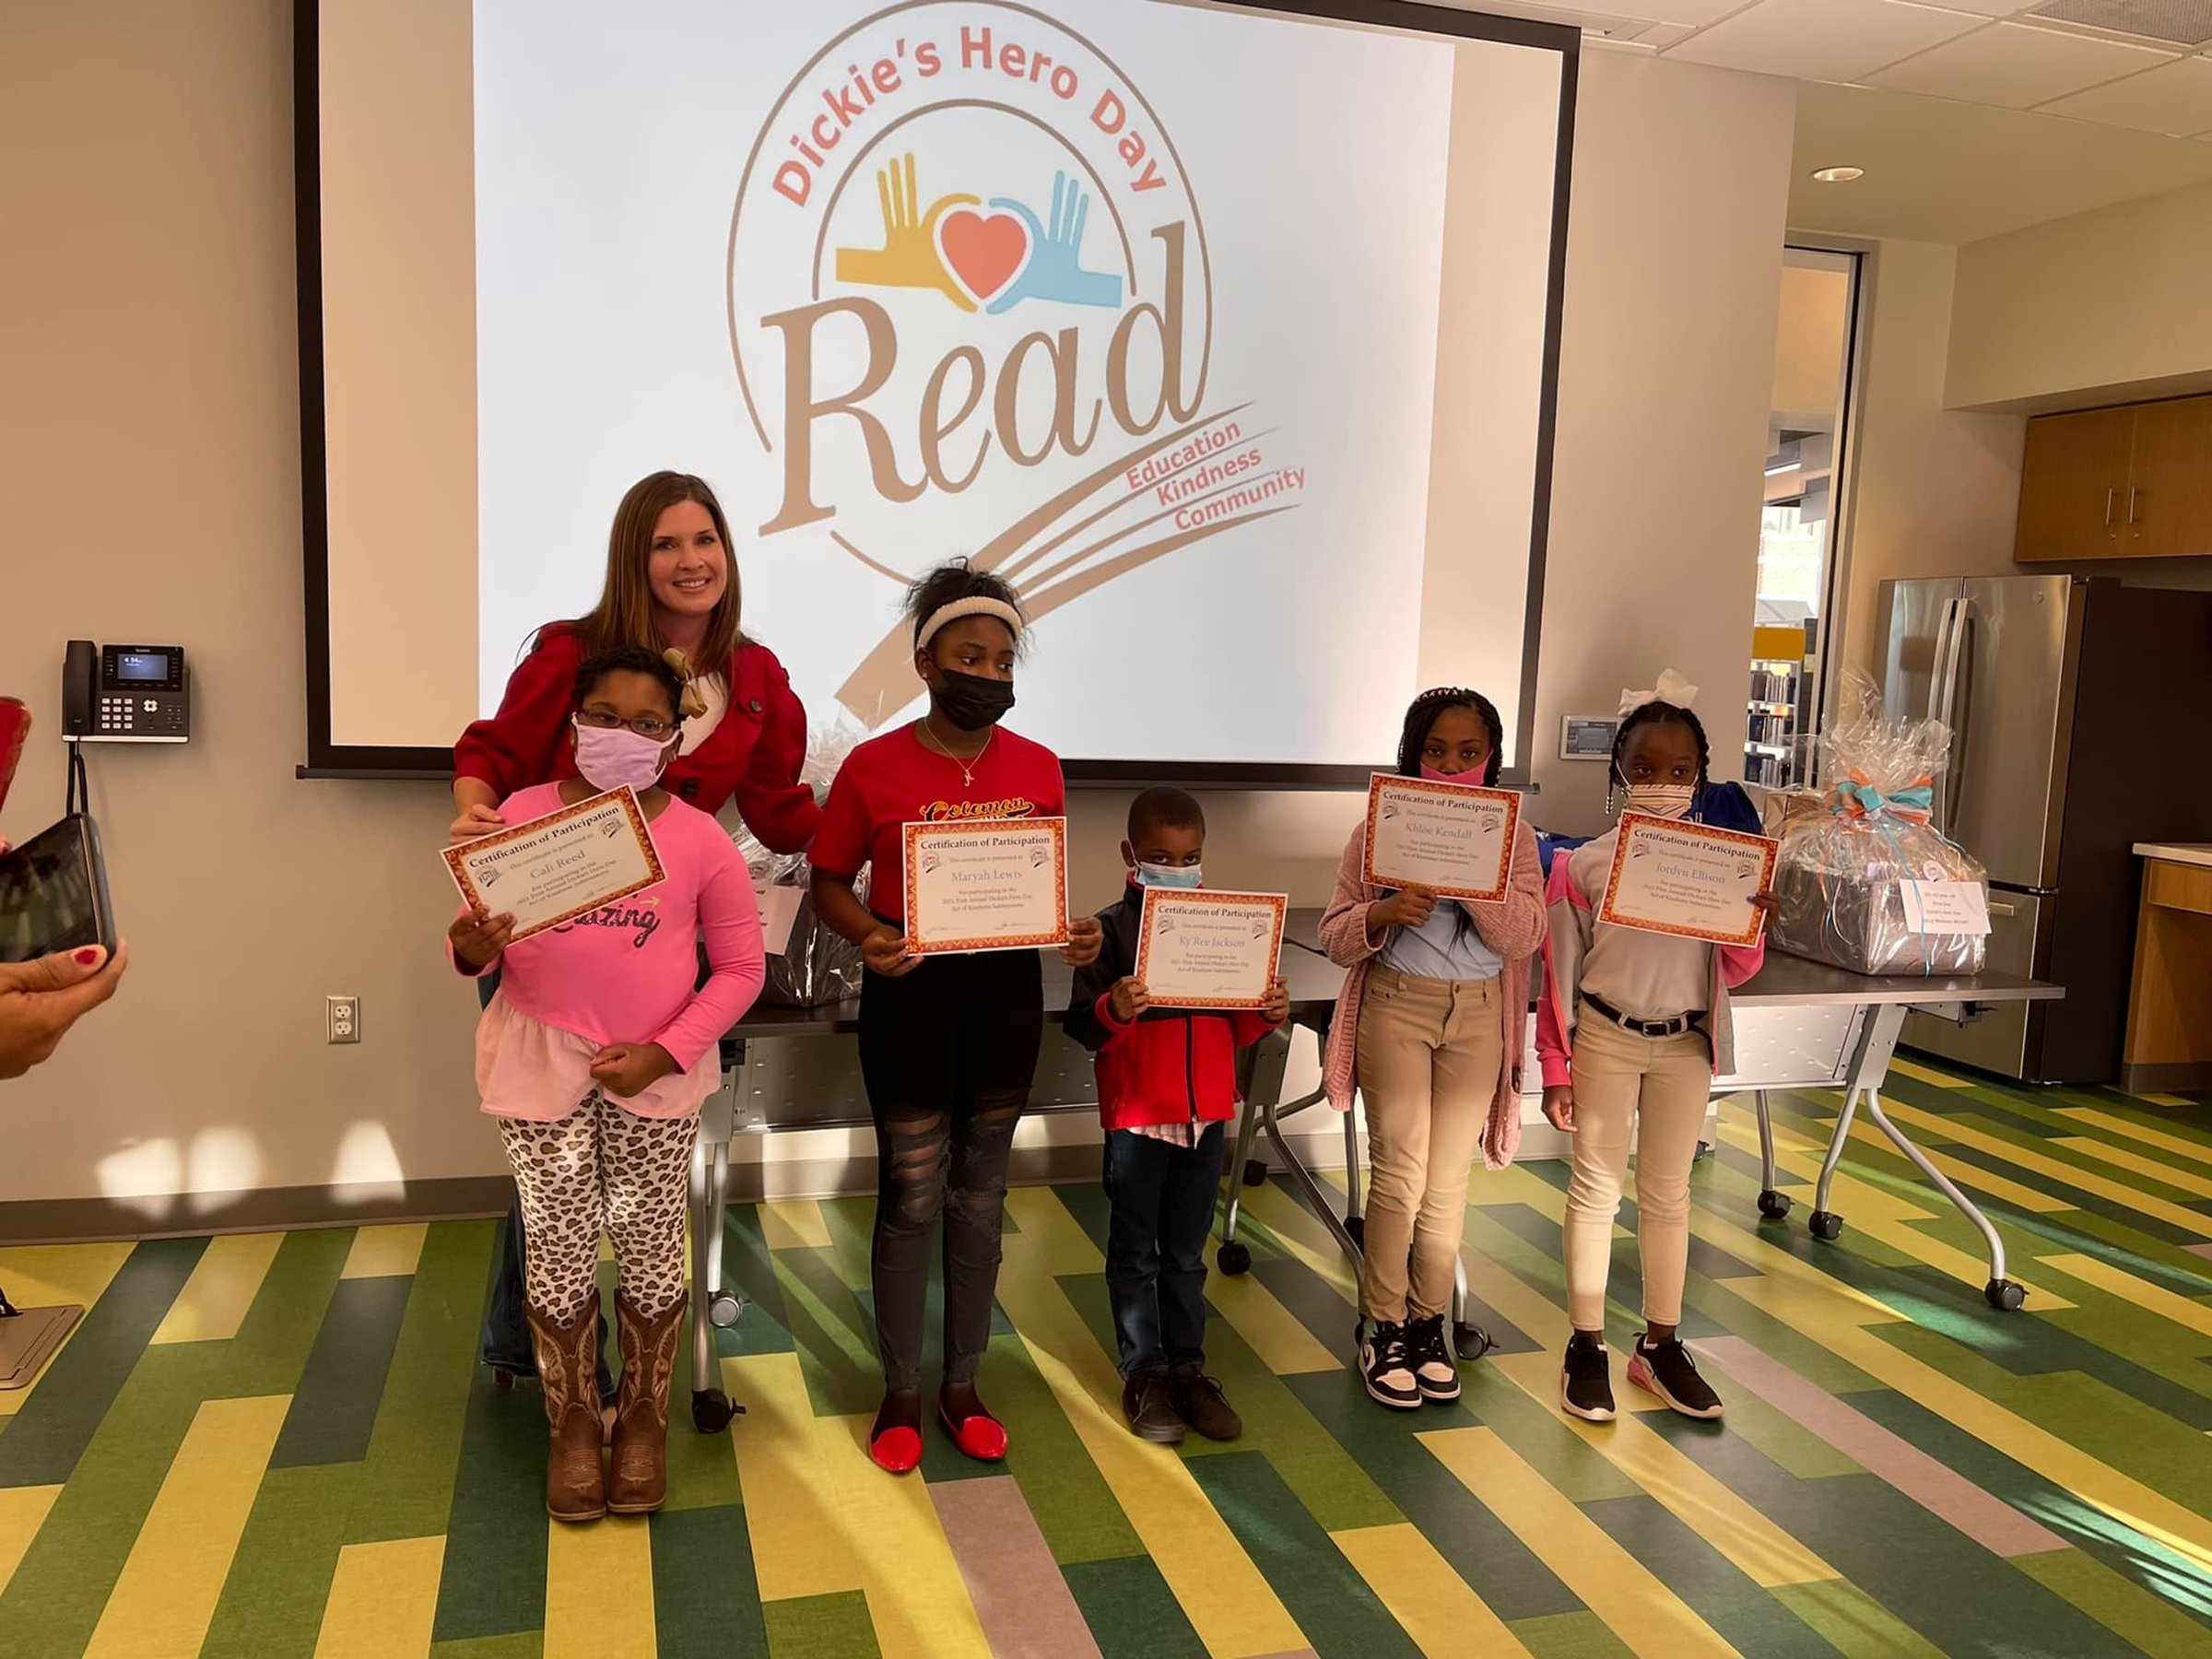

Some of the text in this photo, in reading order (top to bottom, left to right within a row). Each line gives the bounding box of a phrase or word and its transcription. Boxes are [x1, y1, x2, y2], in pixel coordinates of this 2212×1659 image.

[771, 26, 1168, 208] Dickie's Hero Day
[759, 220, 1199, 536] Read
[1125, 422, 1241, 489] Education
[1156, 448, 1262, 506] Kindness
[1174, 466, 1305, 530] Community
[1382, 791, 1503, 815] Certification of Participation
[469, 806, 619, 867] Certification of Participation
[920, 835, 1050, 849] Certification of Participation
[1633, 829, 1689, 846] Certification
[1689, 839, 1700, 848] of
[1701, 841, 1760, 861] Participation
[1158, 904, 1209, 916] Certification
[1220, 908, 1271, 920] Participation
